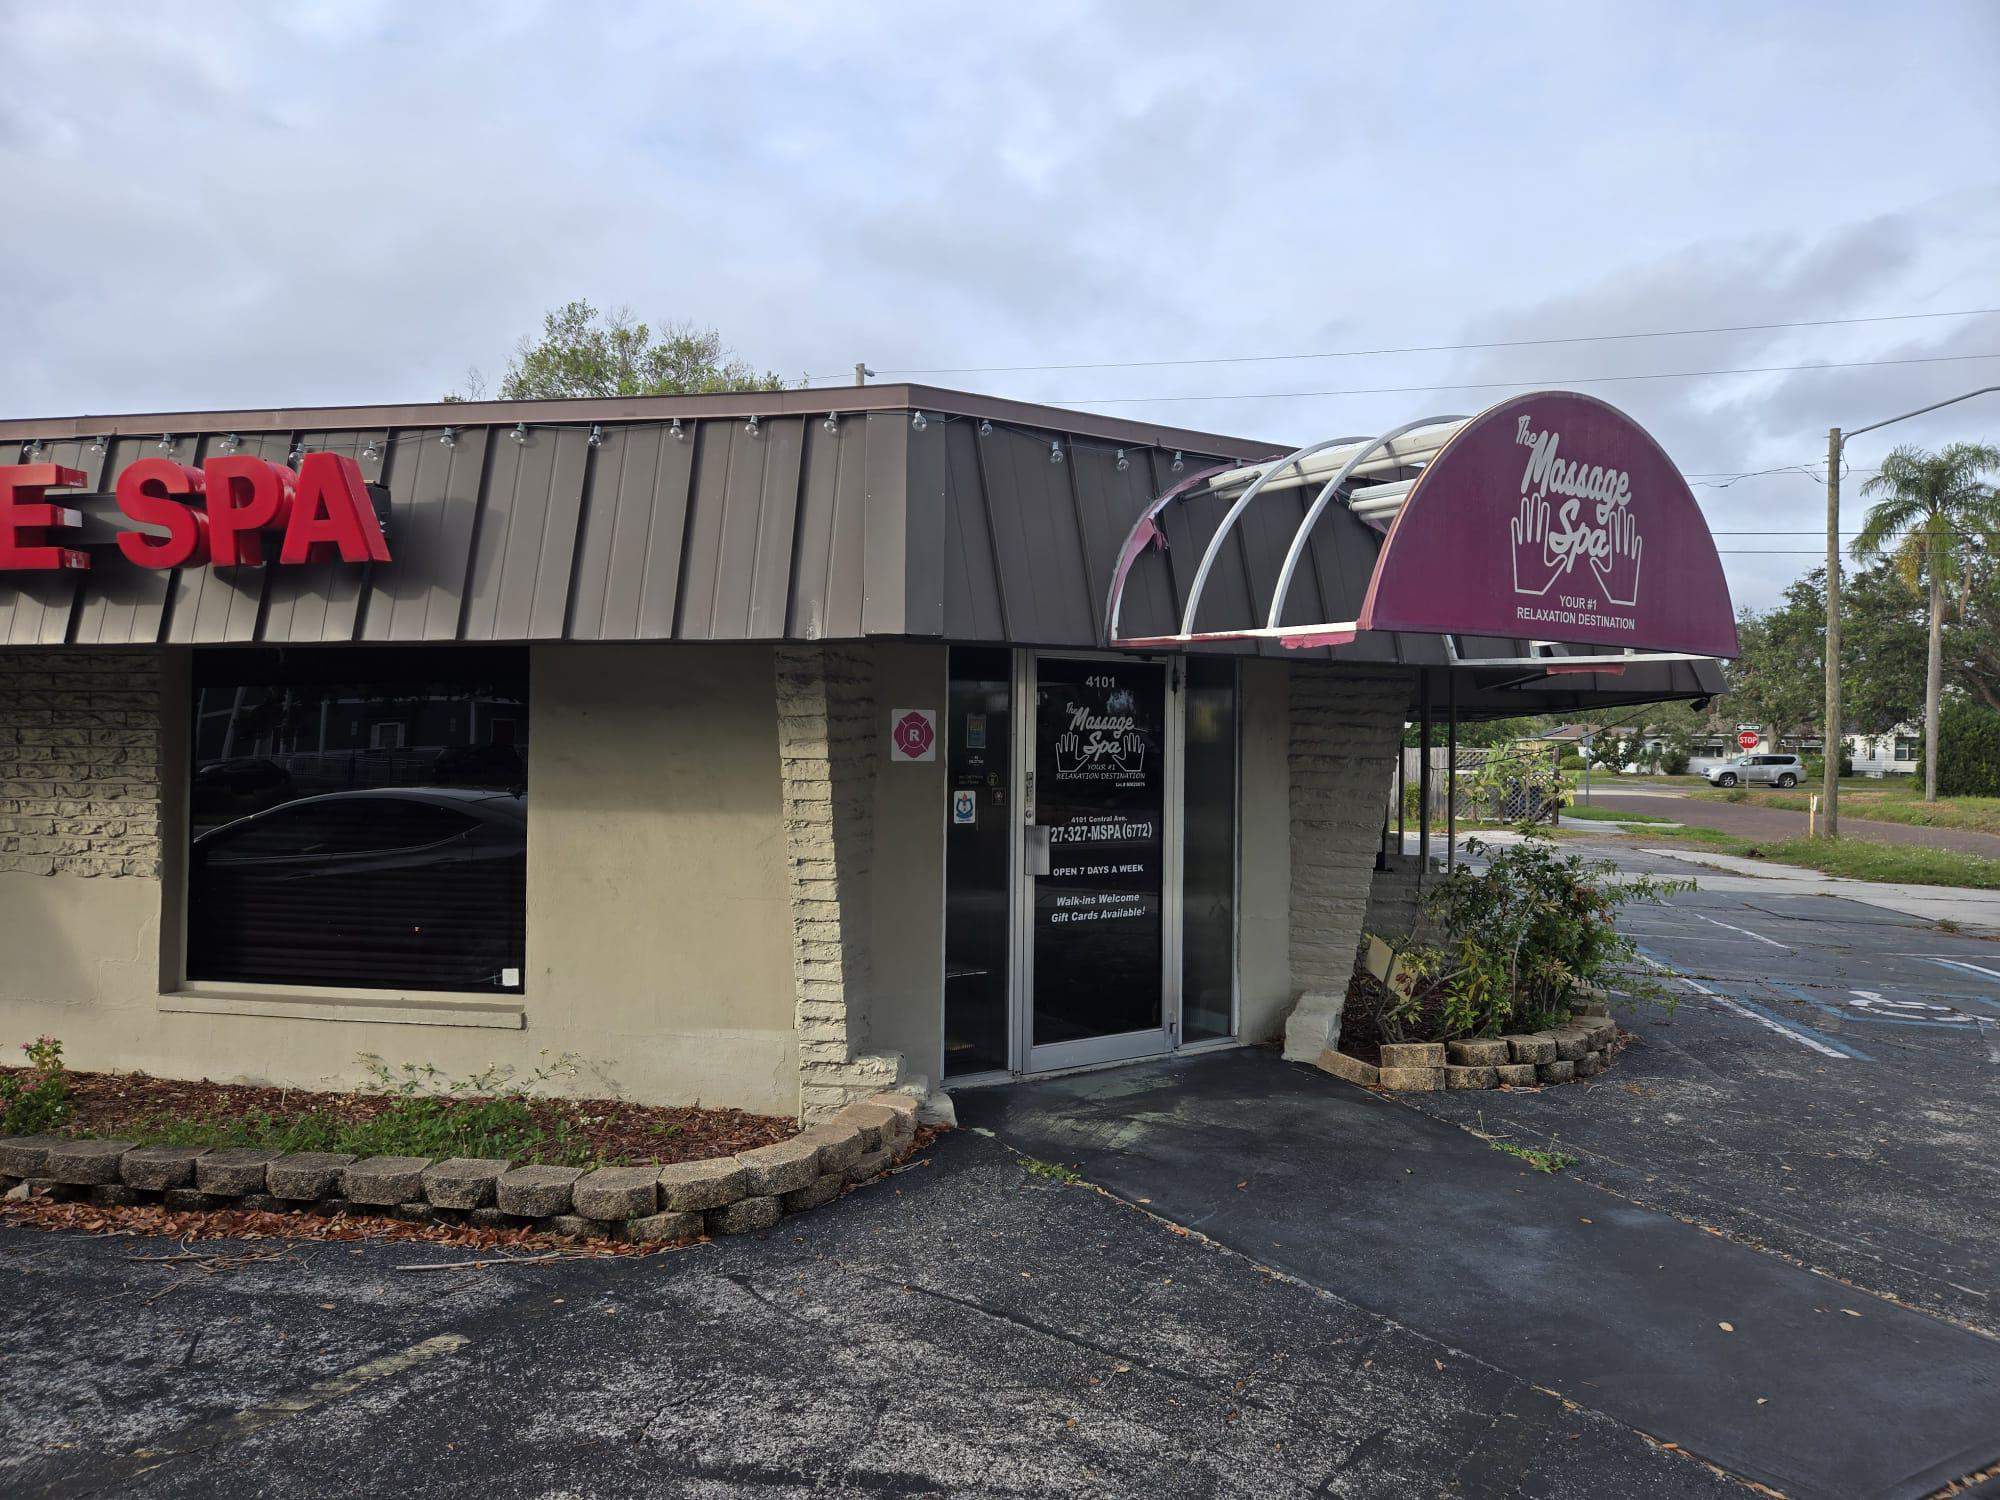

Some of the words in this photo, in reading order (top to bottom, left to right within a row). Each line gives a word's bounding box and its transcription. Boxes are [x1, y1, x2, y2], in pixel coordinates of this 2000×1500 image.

[1516, 415, 1537, 448] The
[1521, 430, 1632, 525] Massage
[116, 452, 392, 570] SPA
[1549, 498, 1611, 573] Spa
[1559, 595, 1585, 610] YOUR
[1587, 598, 1597, 610] #1
[1517, 606, 1576, 625] RELAXATION
[1578, 613, 1635, 630] DESTINATION
[1086, 676, 1115, 688] 4101
[1069, 706, 1135, 738] Massage
[909, 729, 920, 742] R
[1739, 736, 1757, 744] STOP
[1083, 731, 1121, 761] Spa
[1087, 763, 1106, 771] YOUR
[1056, 772, 1099, 780] RELAXATION
[1101, 772, 1146, 780] DESTINATION
[1089, 815, 1113, 823] Central
[1050, 824, 1121, 843] 27-327-MSPA
[1053, 867, 1077, 876] OPEN
[1079, 867, 1085, 875] 7
[1087, 865, 1109, 875] DAYS
[1111, 865, 1118, 873] A
[1120, 864, 1144, 873] WEEK
[1056, 895, 1096, 906] Walk-ins
[1098, 893, 1140, 904] Welcome
[1051, 912, 1069, 922] Gift
[1071, 910, 1099, 921] Cards
[1100, 906, 1146, 919] Available!
